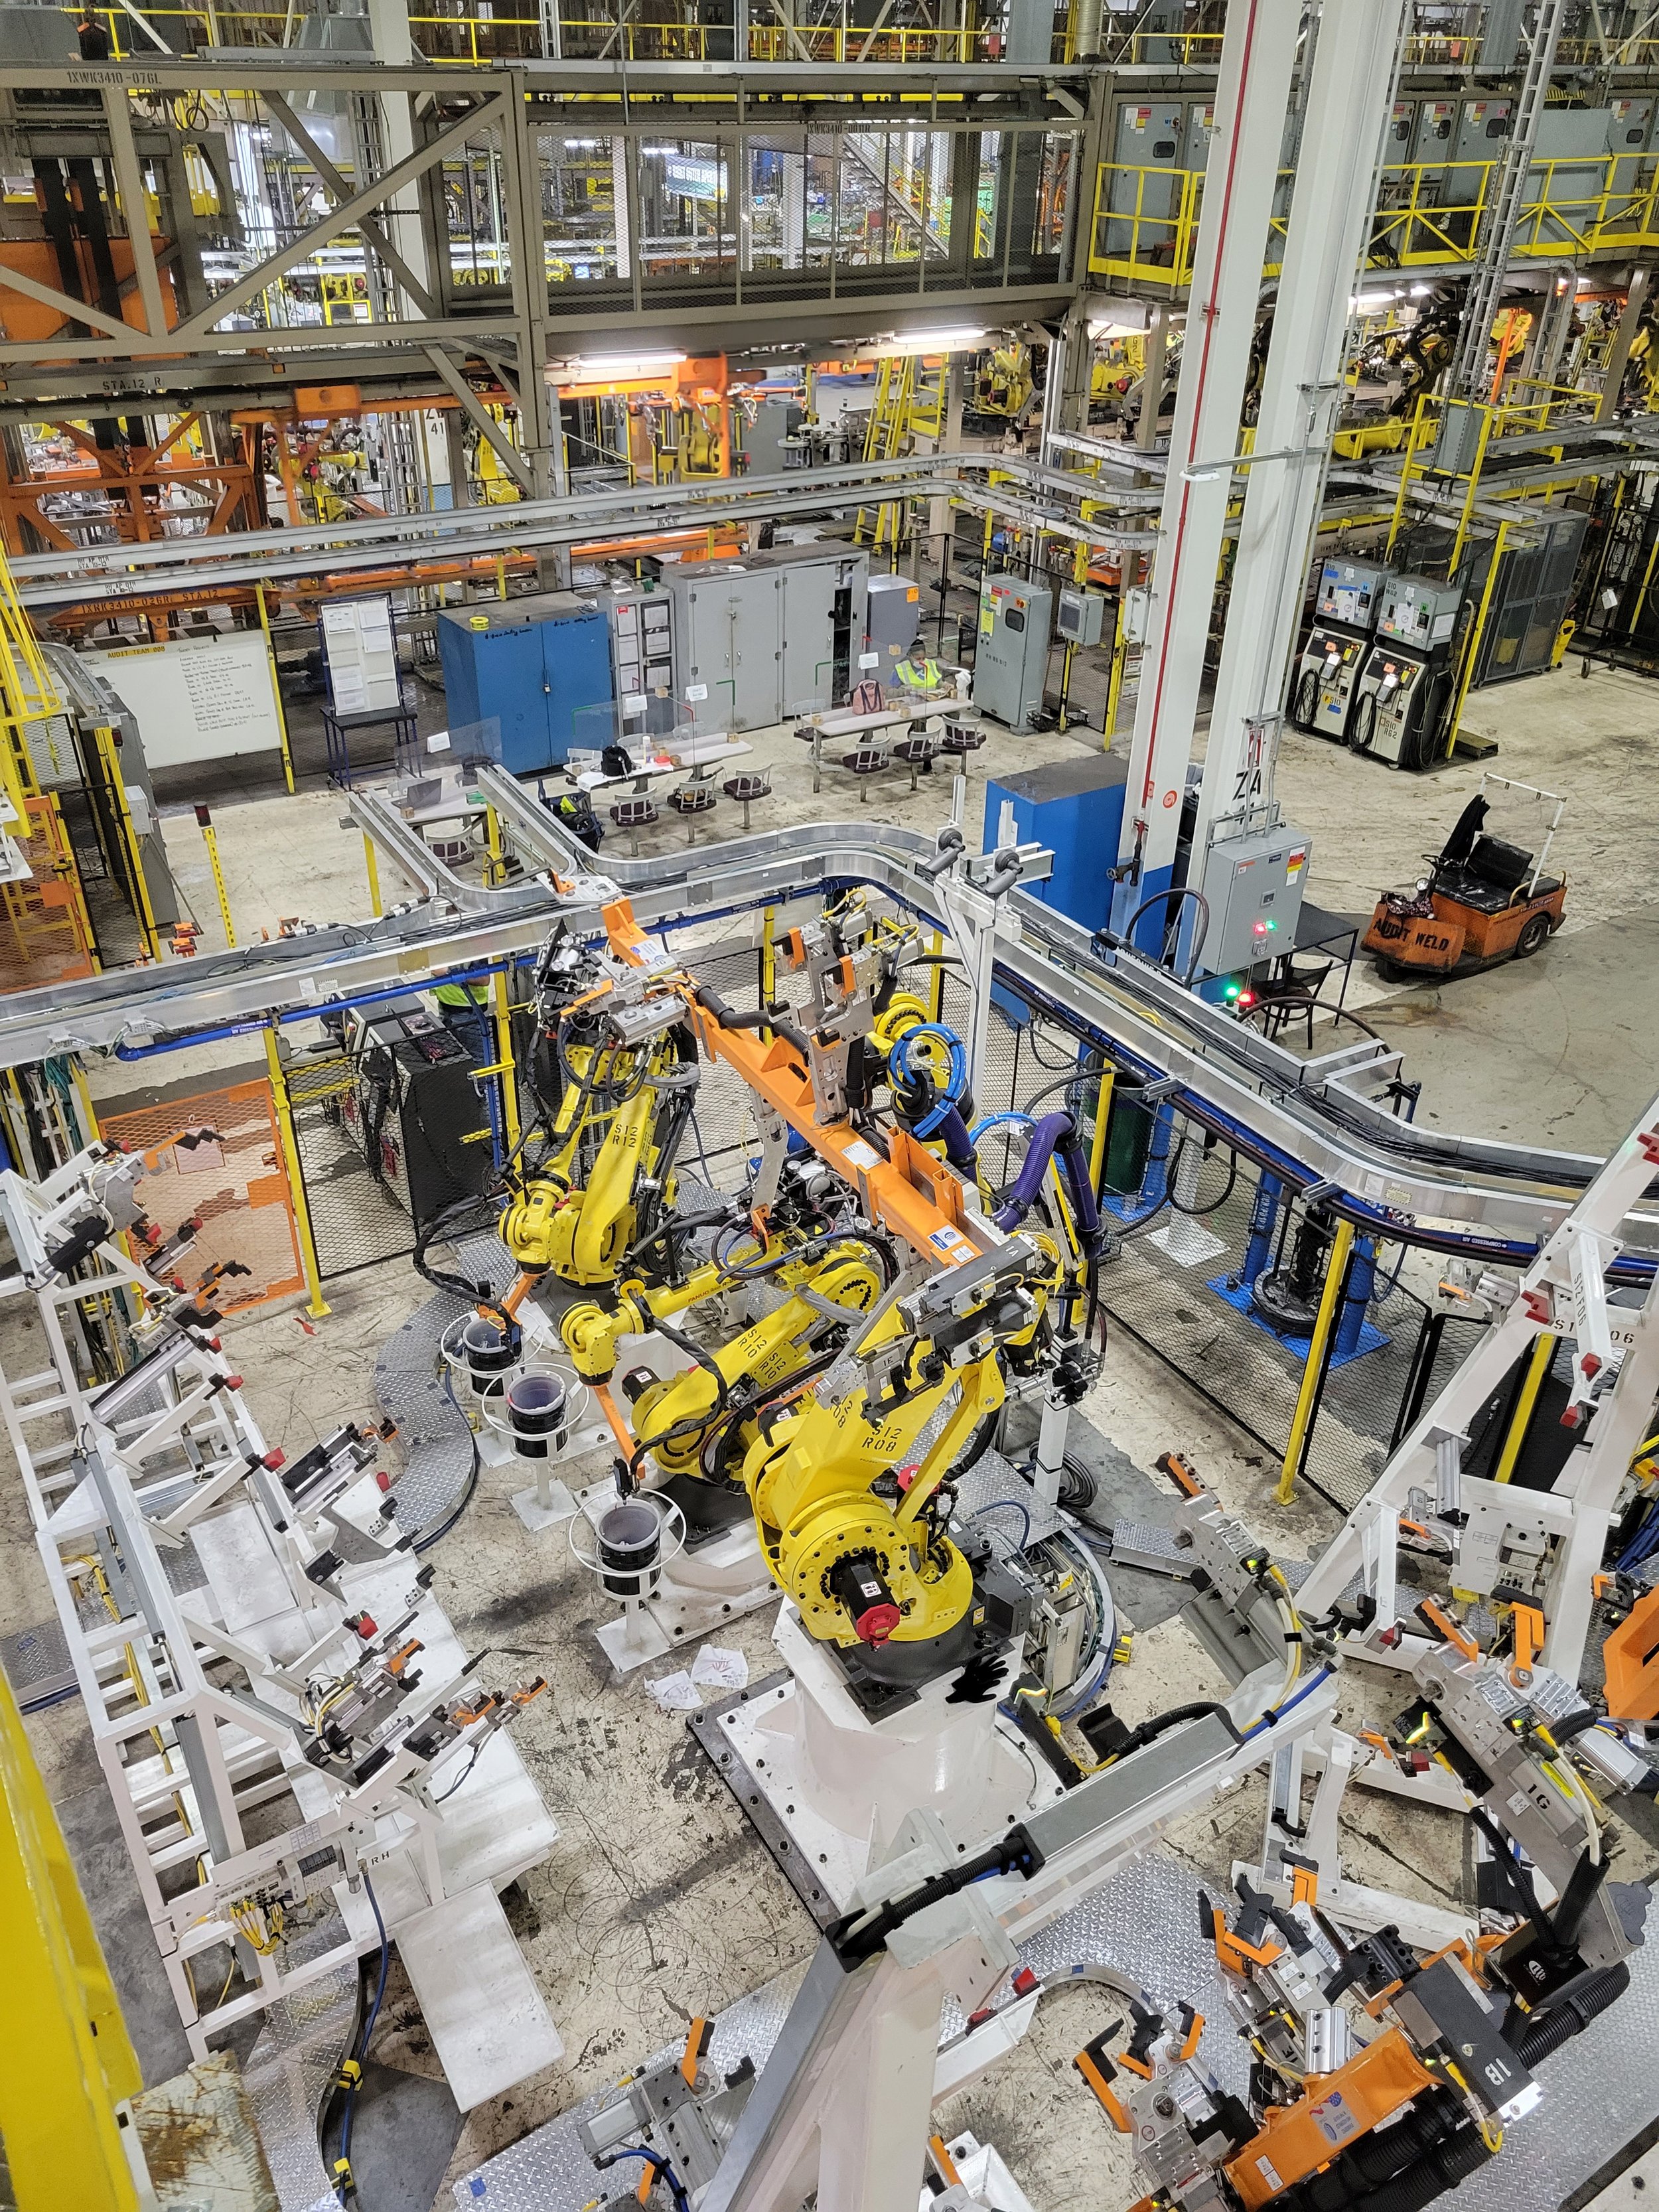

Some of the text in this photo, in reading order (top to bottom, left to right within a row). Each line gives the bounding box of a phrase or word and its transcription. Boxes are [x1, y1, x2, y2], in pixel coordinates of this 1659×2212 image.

[431, 421, 444, 435] 41
[108, 650, 129, 659] AUDIT
[132, 648, 150, 656] TEAM
[1385, 720, 1397, 731] S10
[1415, 932, 1450, 952] WELD
[614, 1124, 638, 1137] S12
[612, 1134, 637, 1148] R12
[1471, 1238, 1502, 1248] COMPRESSED
[687, 1290, 709, 1303] FANUC
[747, 1328, 767, 1350] S12
[737, 1337, 758, 1359] R10
[769, 1351, 787, 1371] S12
[883, 1355, 894, 1366] 1E
[758, 1361, 777, 1380] R10
[871, 1425, 902, 1439] S12
[861, 1436, 897, 1453] R08
[1528, 1783, 1551, 1810] 1G
[370, 1851, 390, 1866] RH
[1484, 2057, 1512, 2086] 1B
